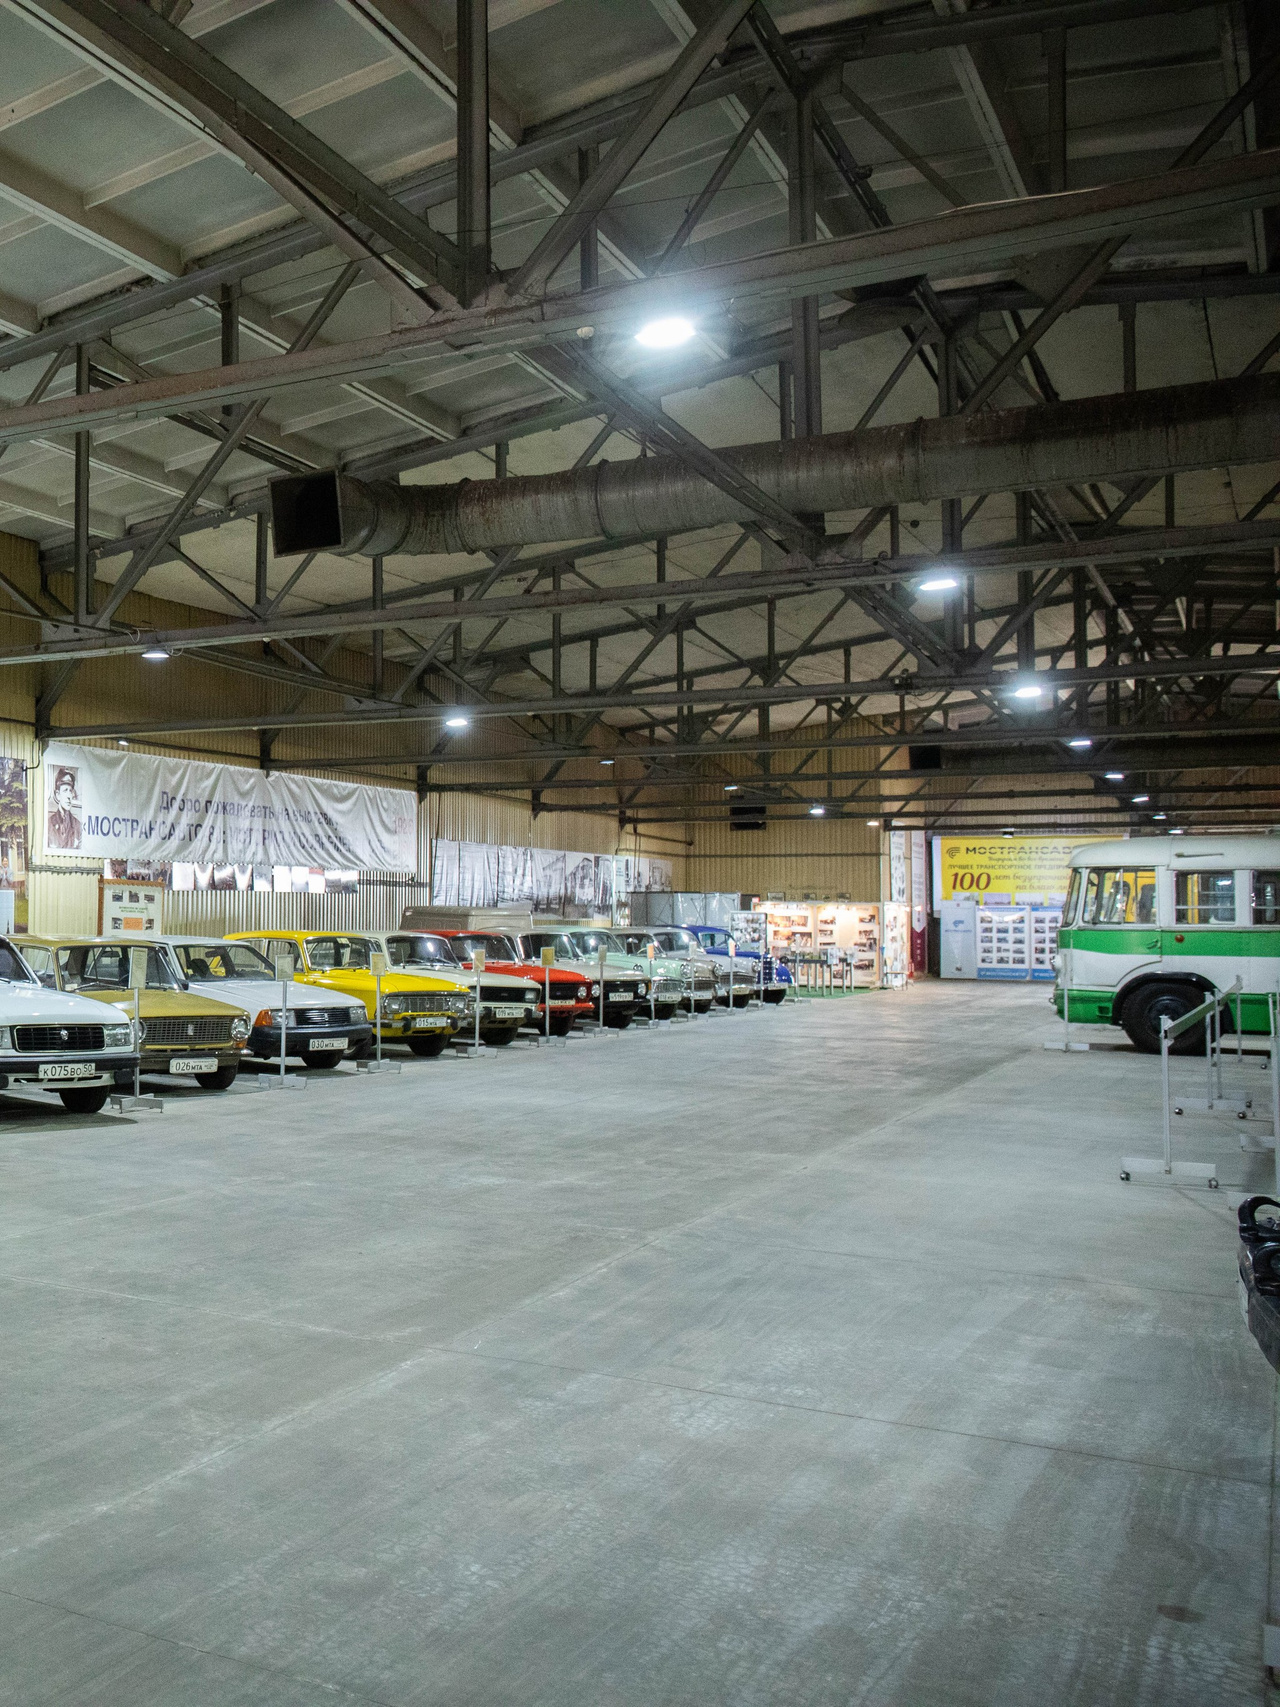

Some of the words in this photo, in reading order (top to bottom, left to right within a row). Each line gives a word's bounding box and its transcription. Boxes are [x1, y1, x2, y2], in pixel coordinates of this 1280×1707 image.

[966, 846, 1072, 855] МОСТРАНСАВ
[952, 872, 991, 891] 100
[84, 1064, 92, 1072] 50
